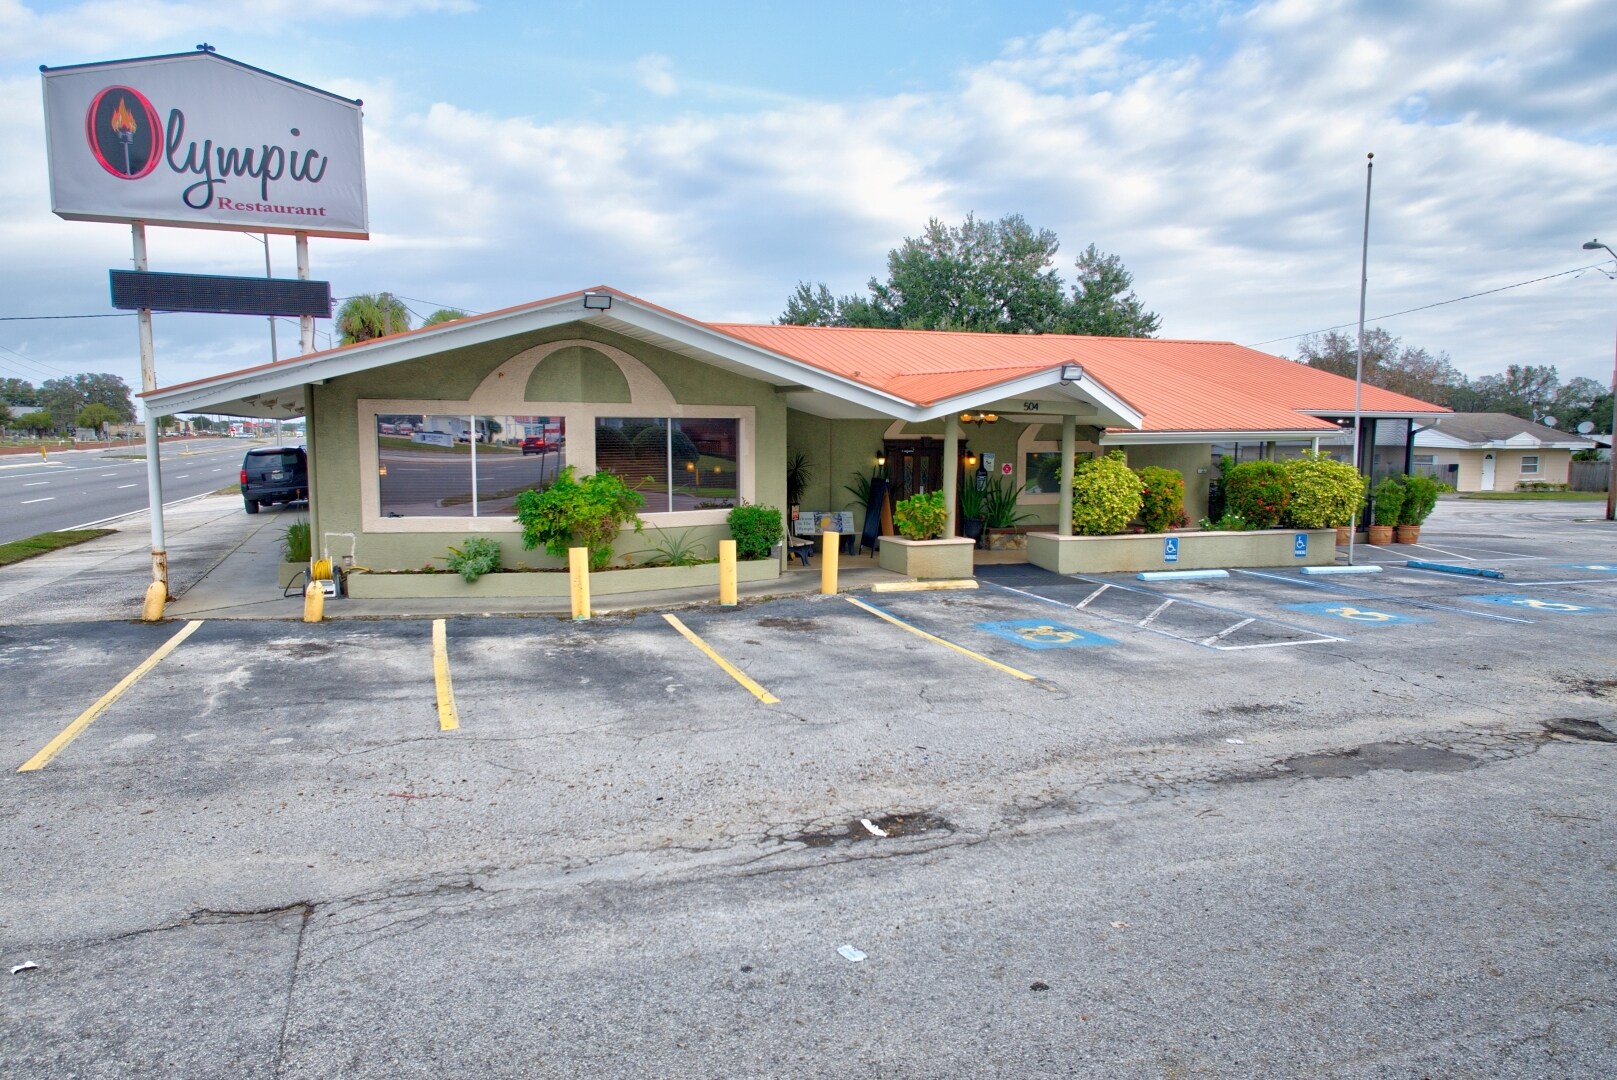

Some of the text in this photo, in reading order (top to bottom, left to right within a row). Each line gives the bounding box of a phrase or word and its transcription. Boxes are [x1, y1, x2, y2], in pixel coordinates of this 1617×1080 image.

[85, 85, 327, 209] Olympic
[217, 196, 327, 217] Restaurant
[1023, 401, 1039, 411] 504
